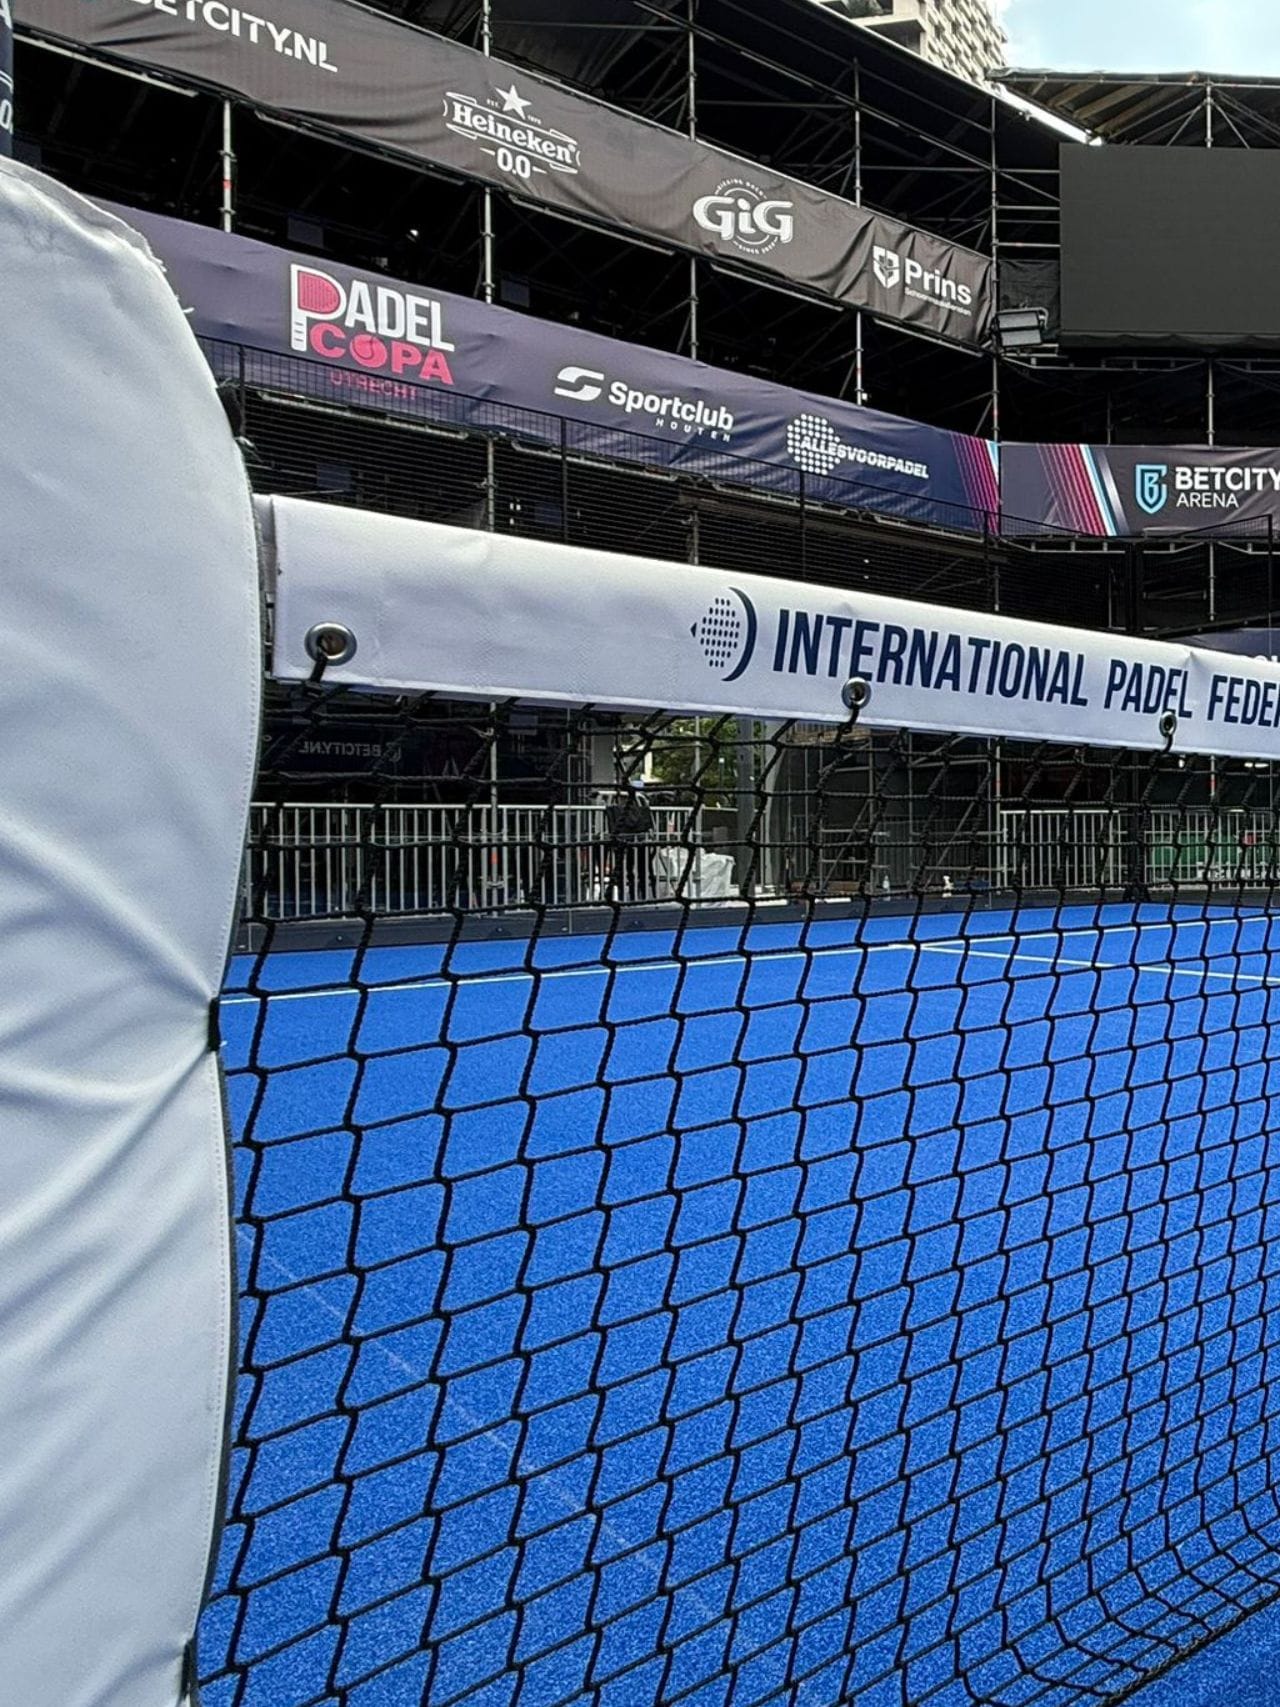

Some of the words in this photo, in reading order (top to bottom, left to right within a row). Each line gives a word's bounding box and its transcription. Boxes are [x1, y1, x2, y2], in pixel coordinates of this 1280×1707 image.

[132, 0, 337, 73] TCITY.NL
[452, 101, 573, 164] Heineken
[497, 147, 531, 179] 0.0
[905, 258, 972, 305] Prins
[291, 263, 455, 352] PADEL
[310, 322, 454, 385] COPA
[329, 369, 418, 400] UTRECHT
[608, 381, 735, 430] Sportclub
[655, 417, 732, 442] HOUTEN
[800, 435, 929, 478] ALLESVOORPADEL
[1176, 492, 1239, 508] ARENA
[773, 609, 1088, 708] INTERNATIONAL
[1104, 658, 1192, 719] PADEL
